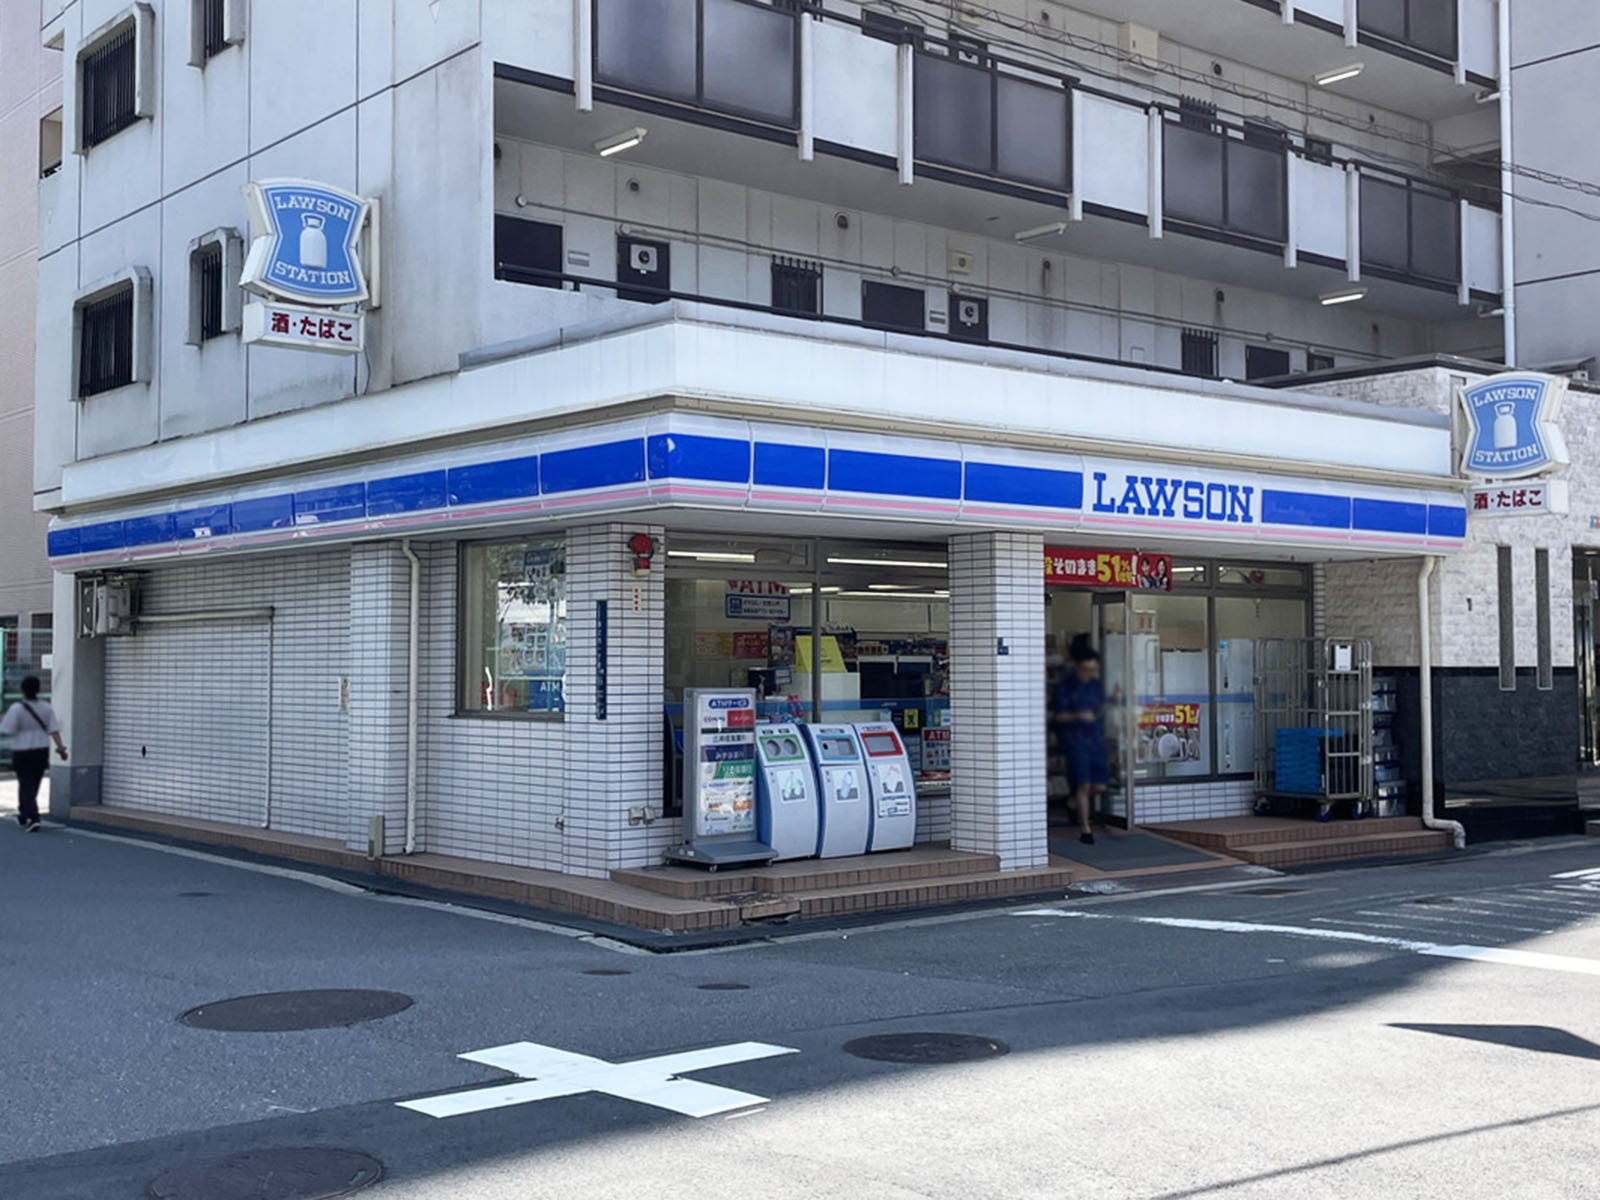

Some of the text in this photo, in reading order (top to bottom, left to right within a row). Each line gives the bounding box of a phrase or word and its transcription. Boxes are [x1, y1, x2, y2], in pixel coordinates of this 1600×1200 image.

[275, 196, 351, 221] LAWSON
[275, 261, 351, 284] STATION
[271, 312, 353, 341] 酒・たばこ
[1473, 387, 1538, 407] LAWSON
[1475, 444, 1539, 463] STATION
[1092, 472, 1254, 523] LAWSON
[1474, 490, 1542, 510] 酒・たばこ
